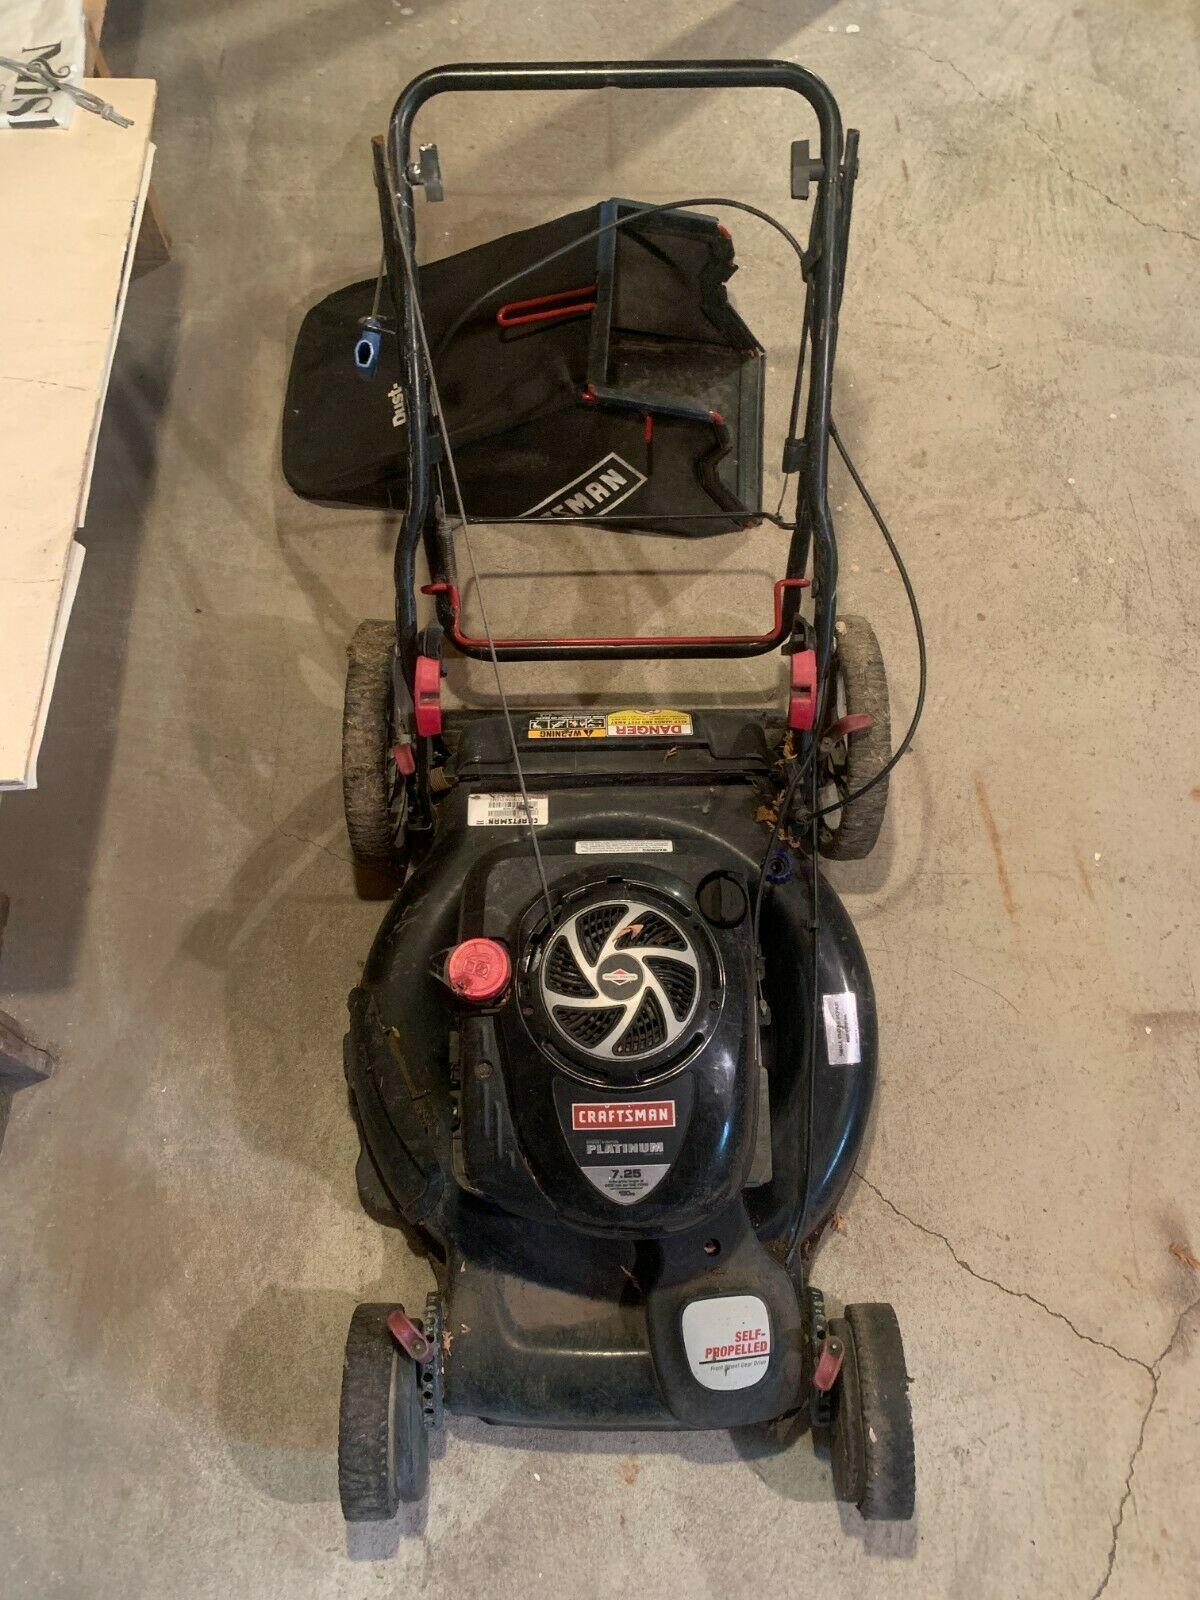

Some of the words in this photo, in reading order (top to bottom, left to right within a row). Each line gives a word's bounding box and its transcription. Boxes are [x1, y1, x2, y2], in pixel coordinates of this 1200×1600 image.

[387, 382, 407, 428] Dust-
[539, 730, 581, 738] WARNING
[615, 725, 682, 735] DANGER
[579, 1108, 668, 1123] CRAFTSMAN
[586, 1142, 663, 1154] PLATINUM
[610, 1169, 642, 1179] 7.25
[735, 1328, 766, 1342] SELF-
[705, 1341, 767, 1359] PROPELLED
